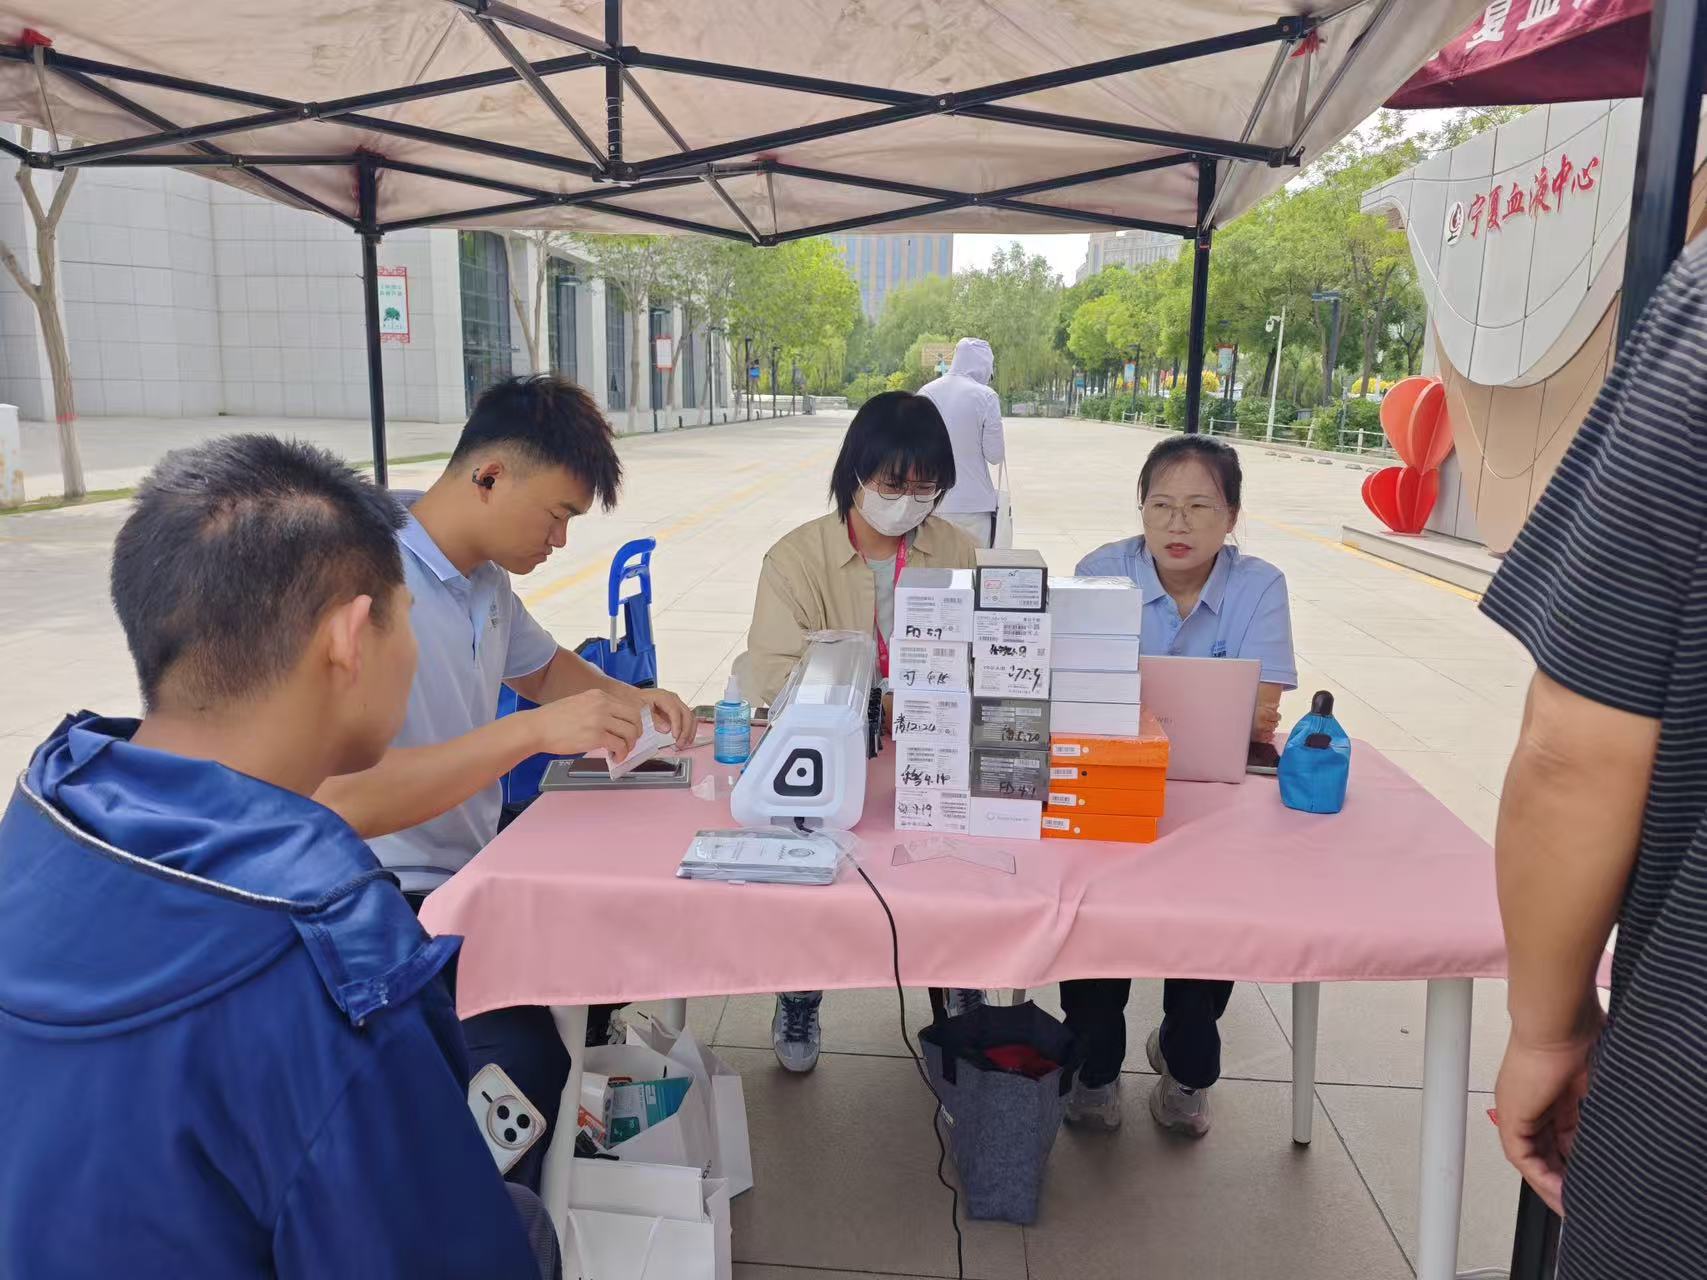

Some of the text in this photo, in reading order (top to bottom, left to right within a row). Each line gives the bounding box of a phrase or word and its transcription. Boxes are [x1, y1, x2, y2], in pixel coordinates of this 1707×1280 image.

[1467, 153, 1601, 239] 宁夏血液中心
